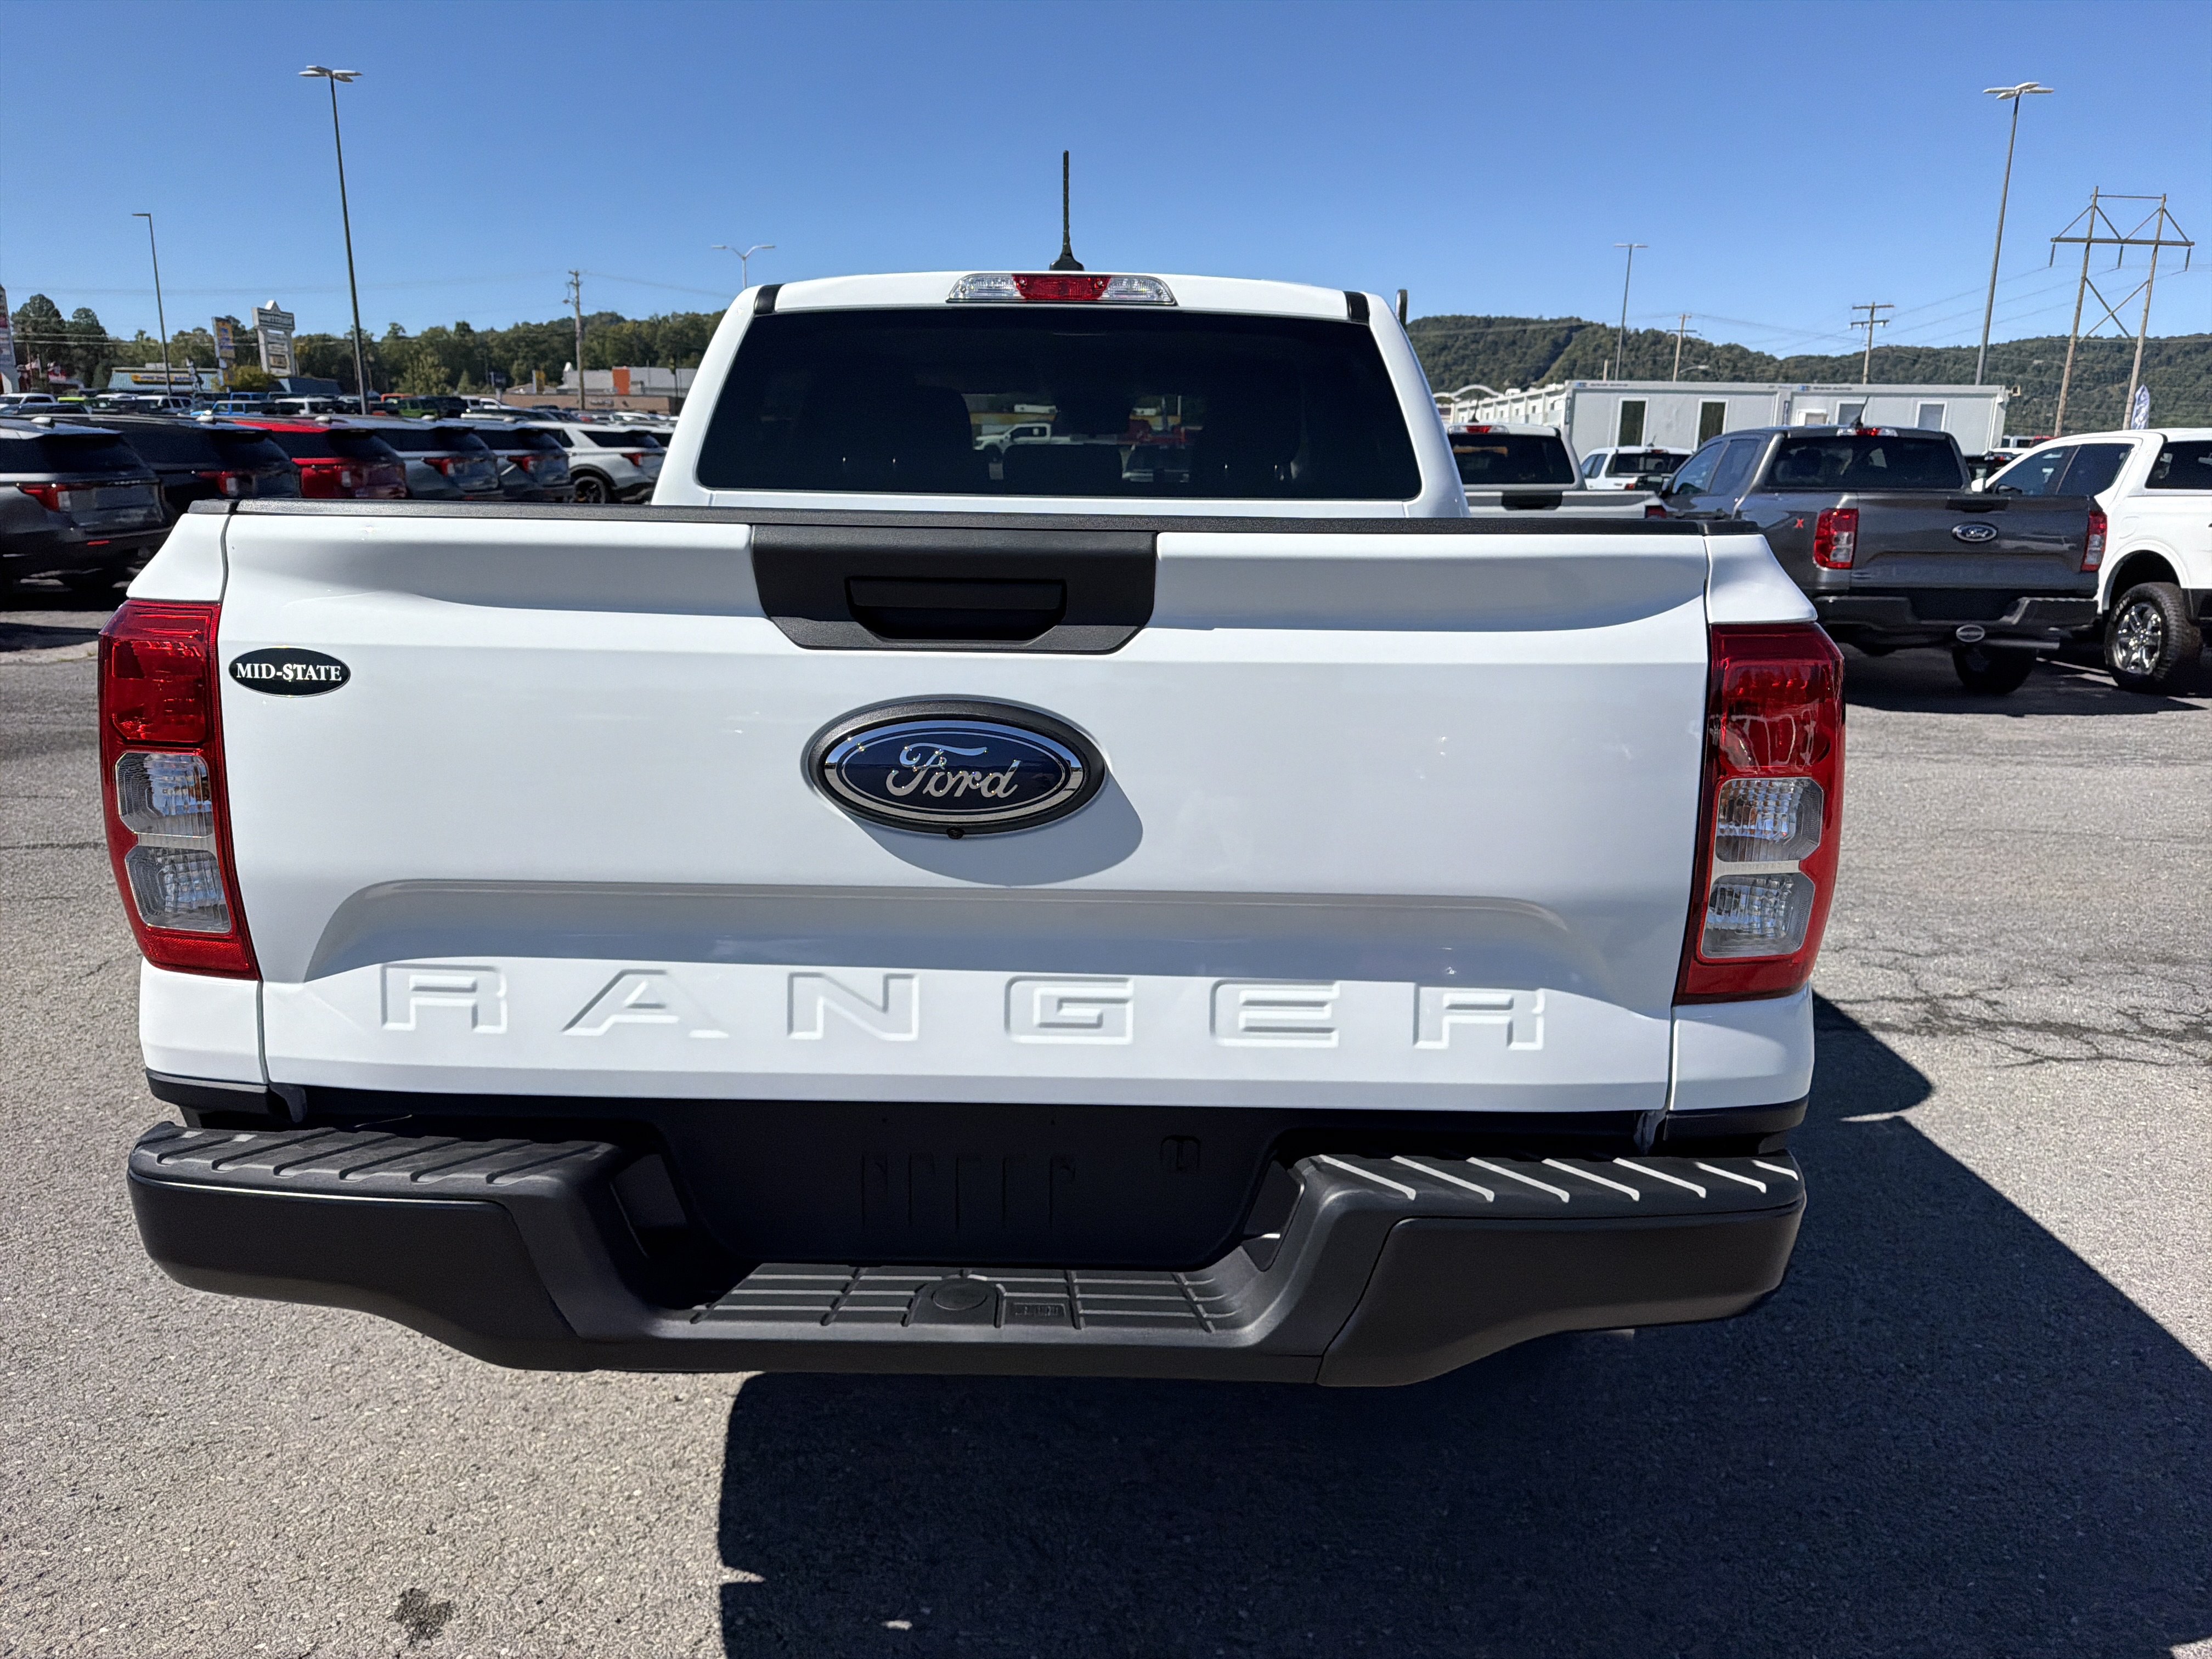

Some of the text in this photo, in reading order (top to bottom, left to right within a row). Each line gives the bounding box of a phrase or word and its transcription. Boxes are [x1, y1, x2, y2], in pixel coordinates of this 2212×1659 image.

[236, 663, 342, 682] MID-STATE
[885, 742, 1022, 798] Ford
[380, 963, 1544, 1050] RANGER
